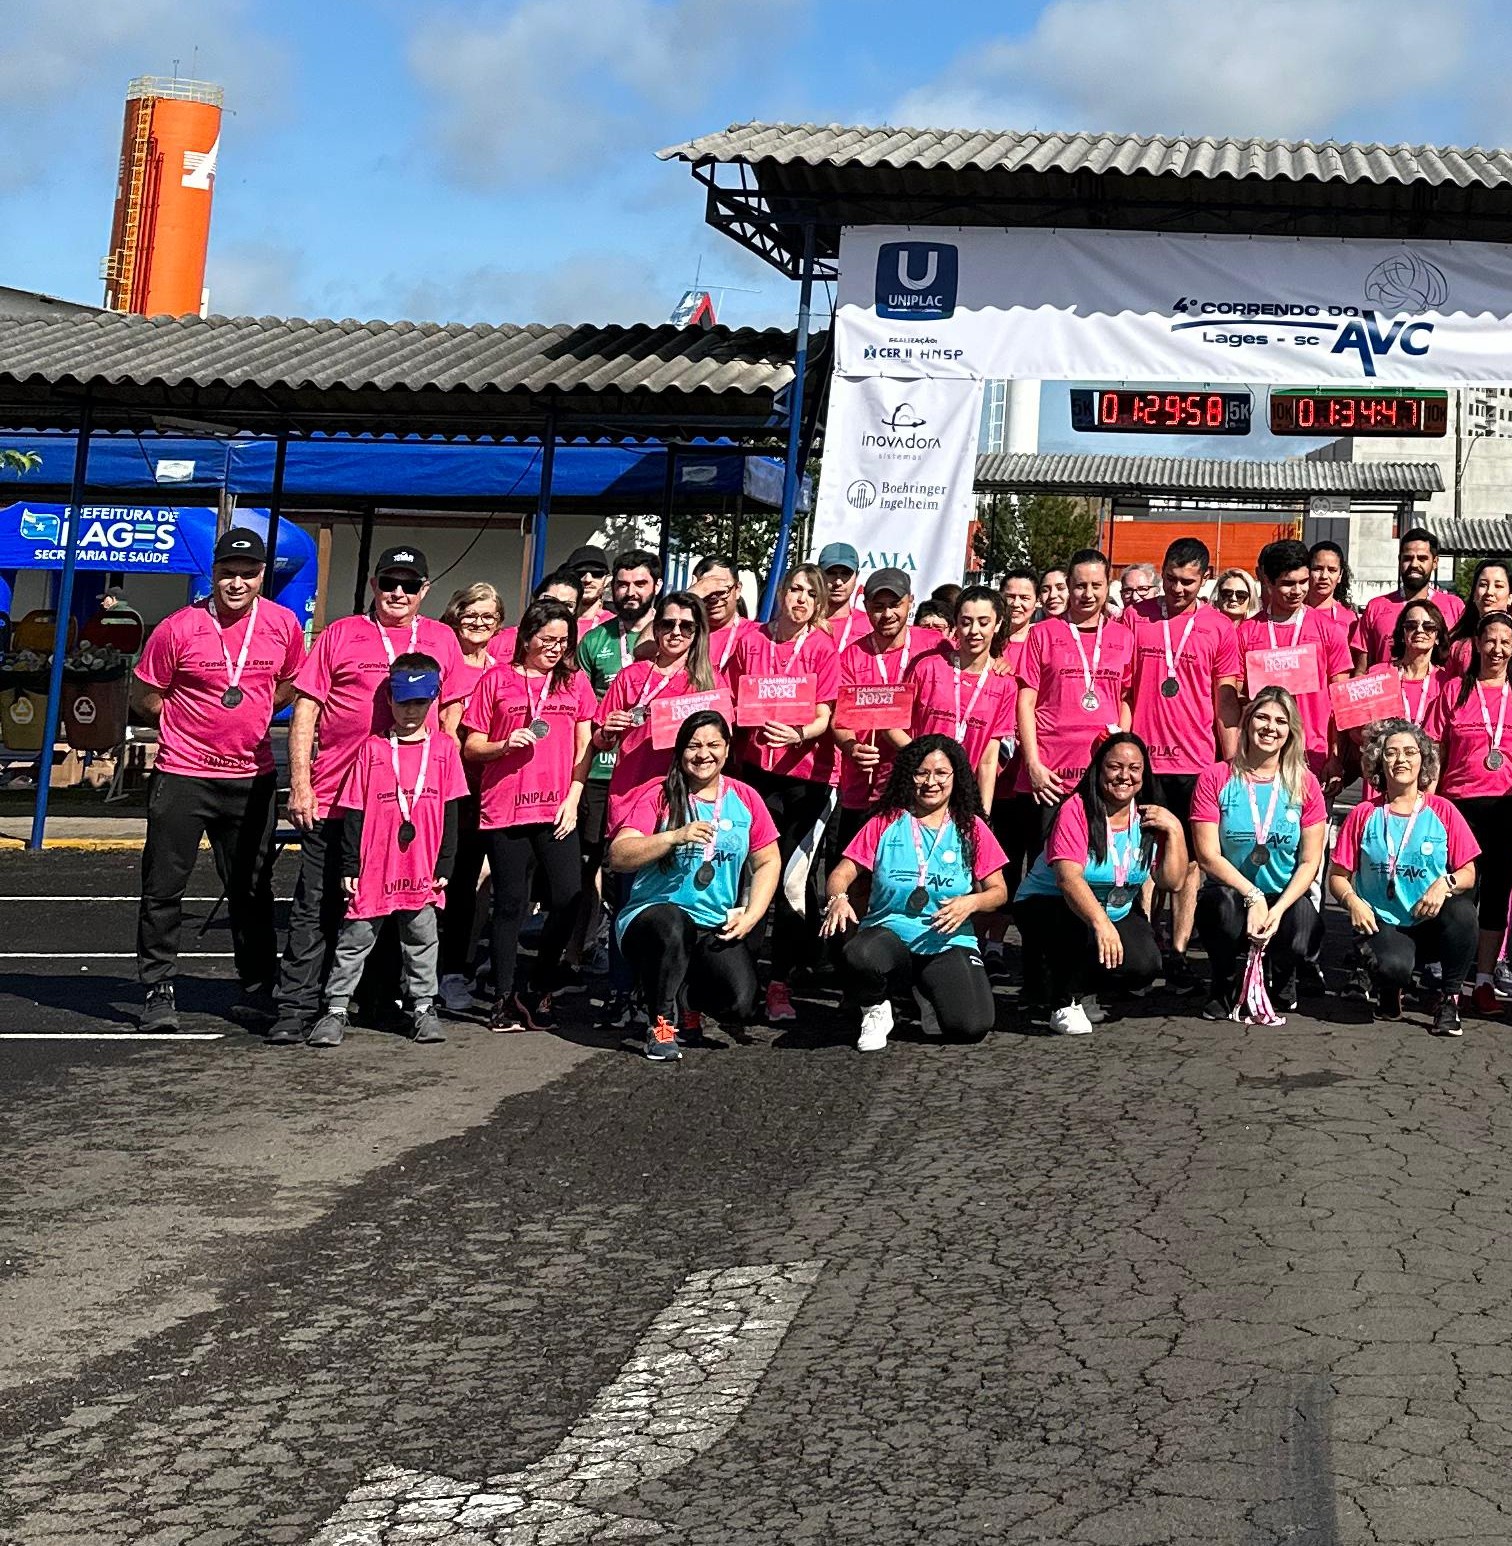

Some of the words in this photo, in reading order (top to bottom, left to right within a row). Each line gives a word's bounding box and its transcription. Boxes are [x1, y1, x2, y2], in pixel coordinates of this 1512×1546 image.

[888, 294, 943, 306] UNIPLAC
[1200, 302, 1319, 317] CORRENDO
[1328, 306, 1359, 317] DO
[1202, 332, 1268, 347] Lages
[1330, 310, 1434, 377] AVC
[879, 348, 901, 359] CER
[920, 349, 964, 360] HNSP
[862, 431, 941, 448] inovadora
[878, 453, 922, 461] sistemas
[881, 481, 948, 496] Boehringer
[879, 497, 939, 511] Ingelheim
[65, 507, 154, 521] PEFEITURA
[157, 509, 179, 522] DE
[34, 549, 107, 561] SECRTARIA
[110, 551, 126, 562] DE
[128, 550, 170, 563] SAÚDE
[1269, 832, 1291, 848] AVC
[713, 850, 736, 868] AVC
[1405, 866, 1427, 883] AVC
[927, 875, 954, 892] AVC
